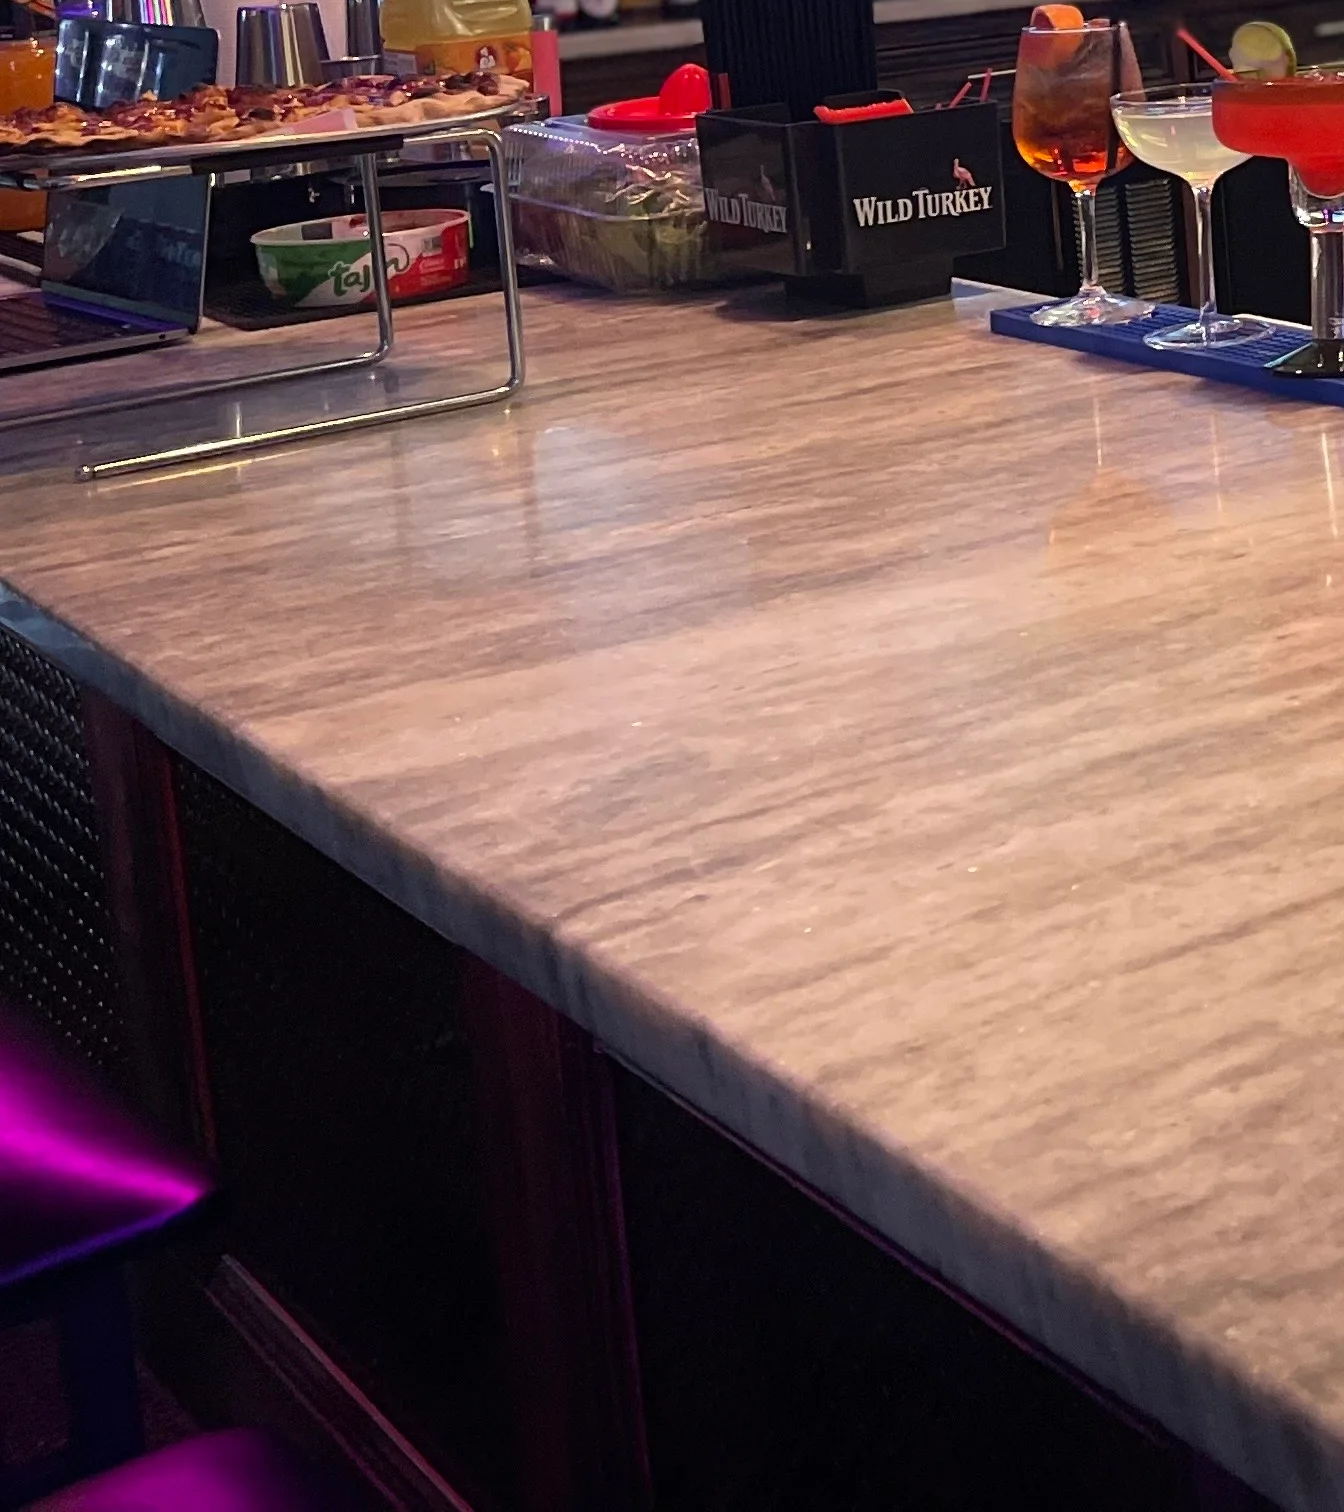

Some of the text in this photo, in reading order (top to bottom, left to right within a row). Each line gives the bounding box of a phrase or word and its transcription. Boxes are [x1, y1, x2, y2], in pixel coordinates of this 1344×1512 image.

[704, 187, 787, 233] WILD TURKEY
[852, 186, 993, 228] WILD TURKEY
